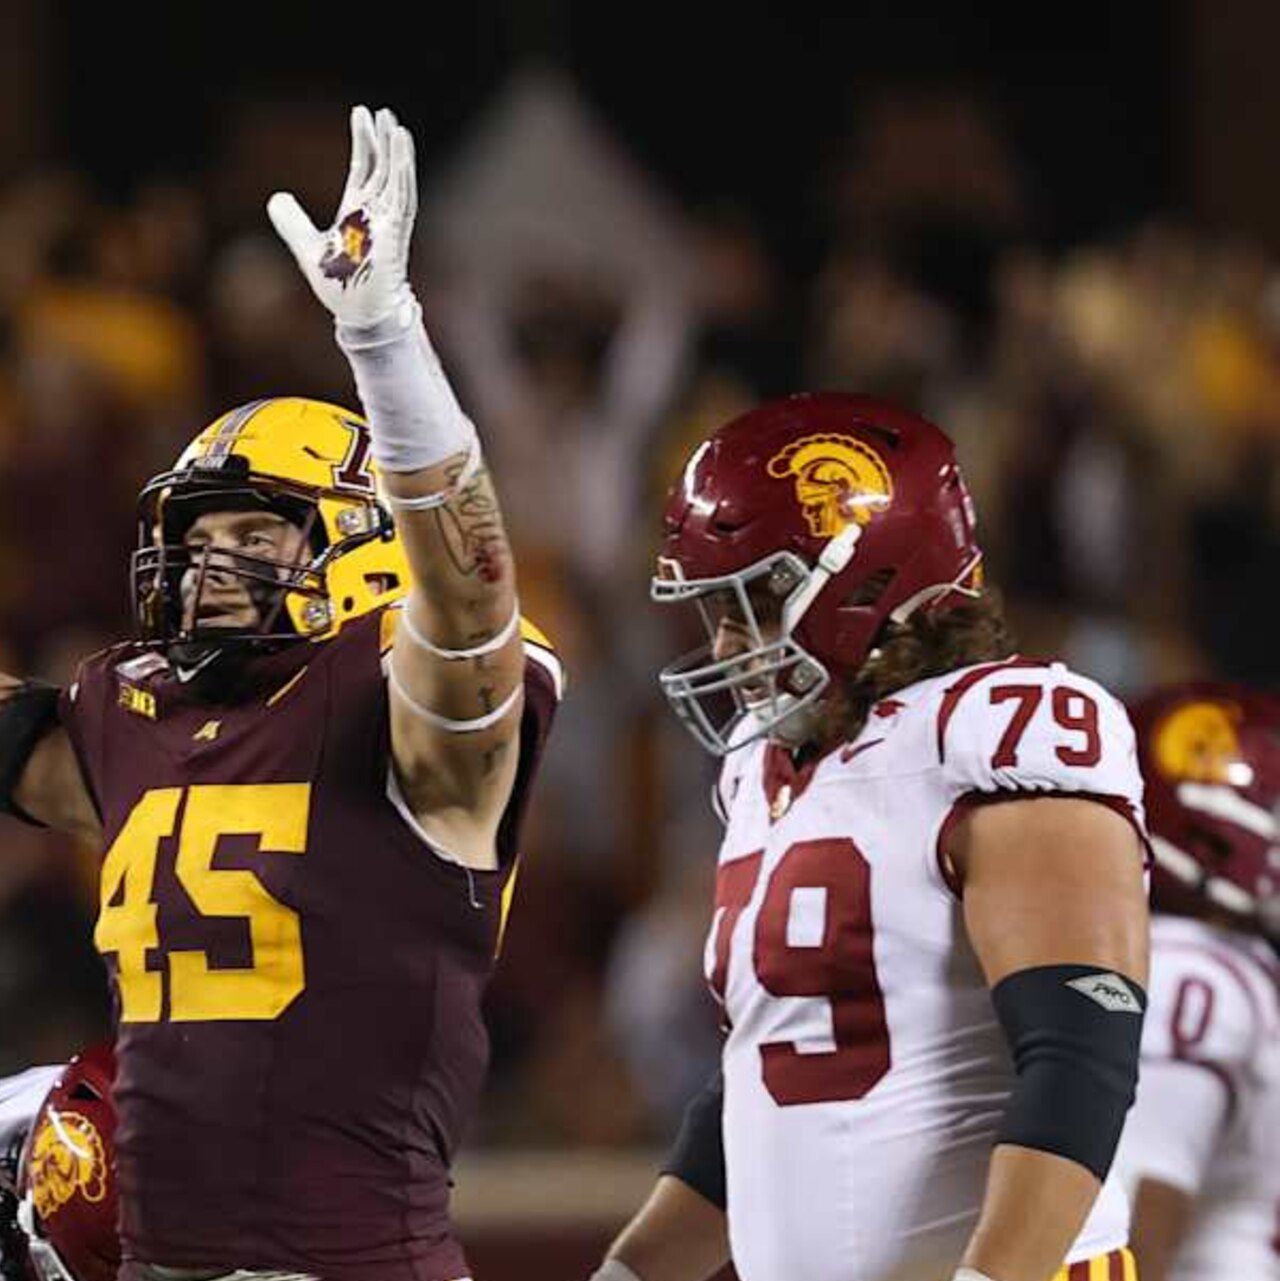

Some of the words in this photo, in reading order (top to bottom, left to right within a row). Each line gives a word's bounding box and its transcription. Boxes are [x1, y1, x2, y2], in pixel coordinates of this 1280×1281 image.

[989, 684, 1103, 769] 79
[92, 781, 311, 1024] 45
[703, 836, 893, 1107] 79
